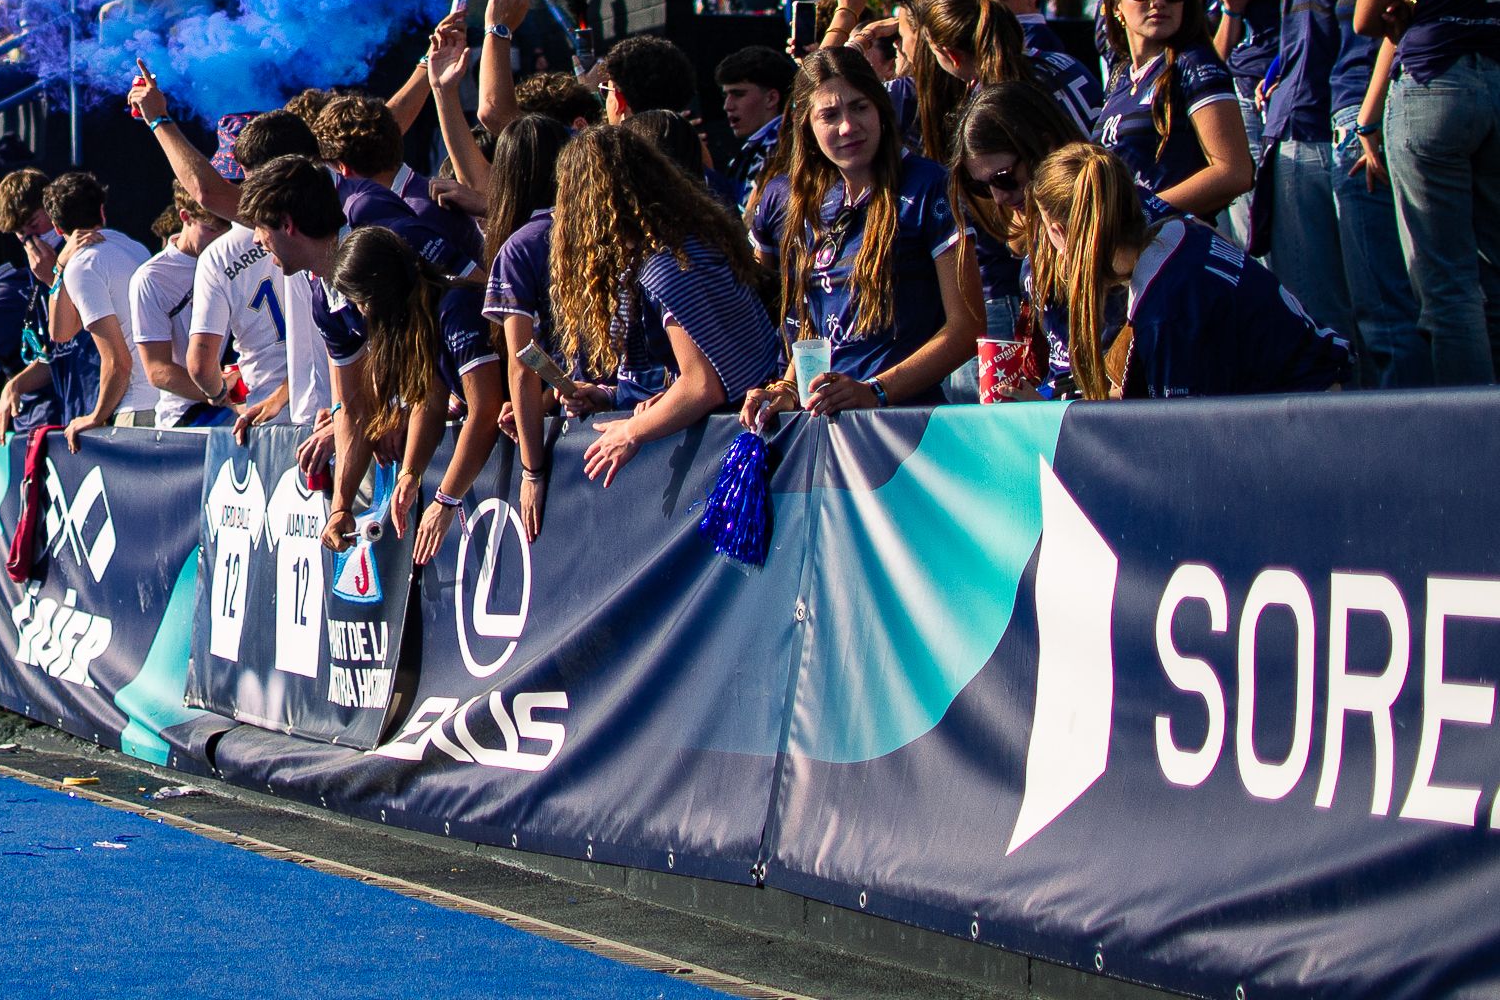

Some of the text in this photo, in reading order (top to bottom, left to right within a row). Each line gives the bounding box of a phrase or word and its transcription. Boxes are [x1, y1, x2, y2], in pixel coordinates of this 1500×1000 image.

[993, 343, 1021, 363] ESTRELLA
[222, 552, 240, 618] 12
[292, 556, 310, 626] 12
[346, 621, 372, 661] DE
[368, 621, 389, 661] LA
[1154, 561, 1500, 833] SORE
[365, 690, 569, 773] EXUS
